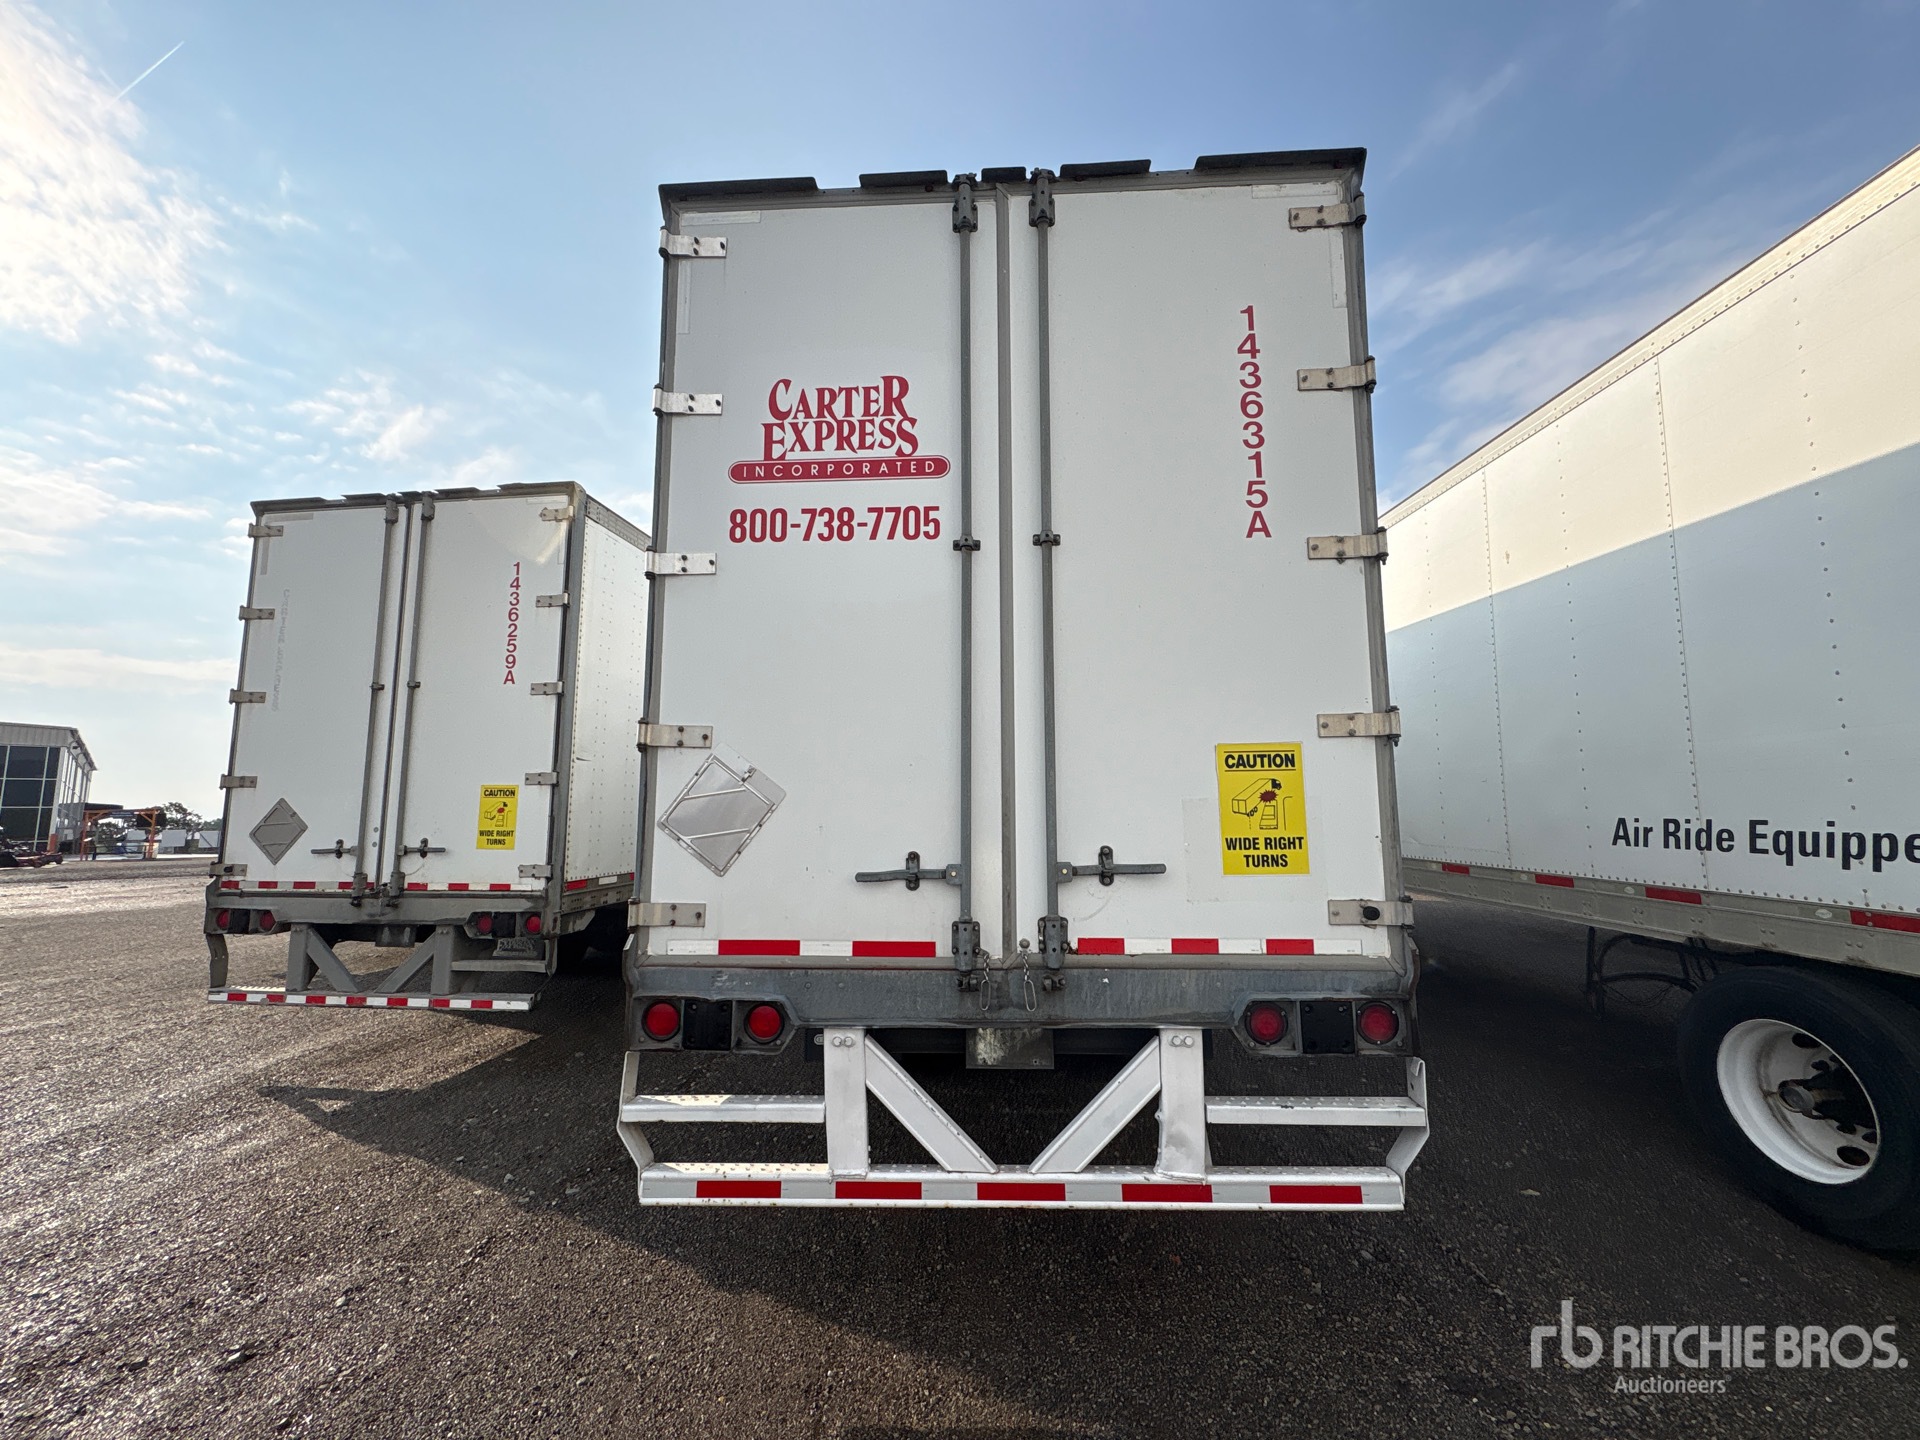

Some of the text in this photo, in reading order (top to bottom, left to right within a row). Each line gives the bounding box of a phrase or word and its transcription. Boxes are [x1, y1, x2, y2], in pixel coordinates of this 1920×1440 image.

[768, 375, 910, 421] CARTER
[761, 417, 919, 461] EXPRESS
[1237, 305, 1272, 538] 1436315A
[743, 460, 935, 478] INCORPORATED
[729, 505, 941, 544] 800-738-7705
[503, 561, 521, 685] 1436259A
[1224, 753, 1296, 770] CAUTION
[484, 789, 515, 797] CAUTION
[1225, 836, 1304, 851] WIDE RIGHT
[1611, 817, 1653, 848] Air
[1662, 817, 1735, 853] Ride
[1243, 853, 1288, 868] TURNS
